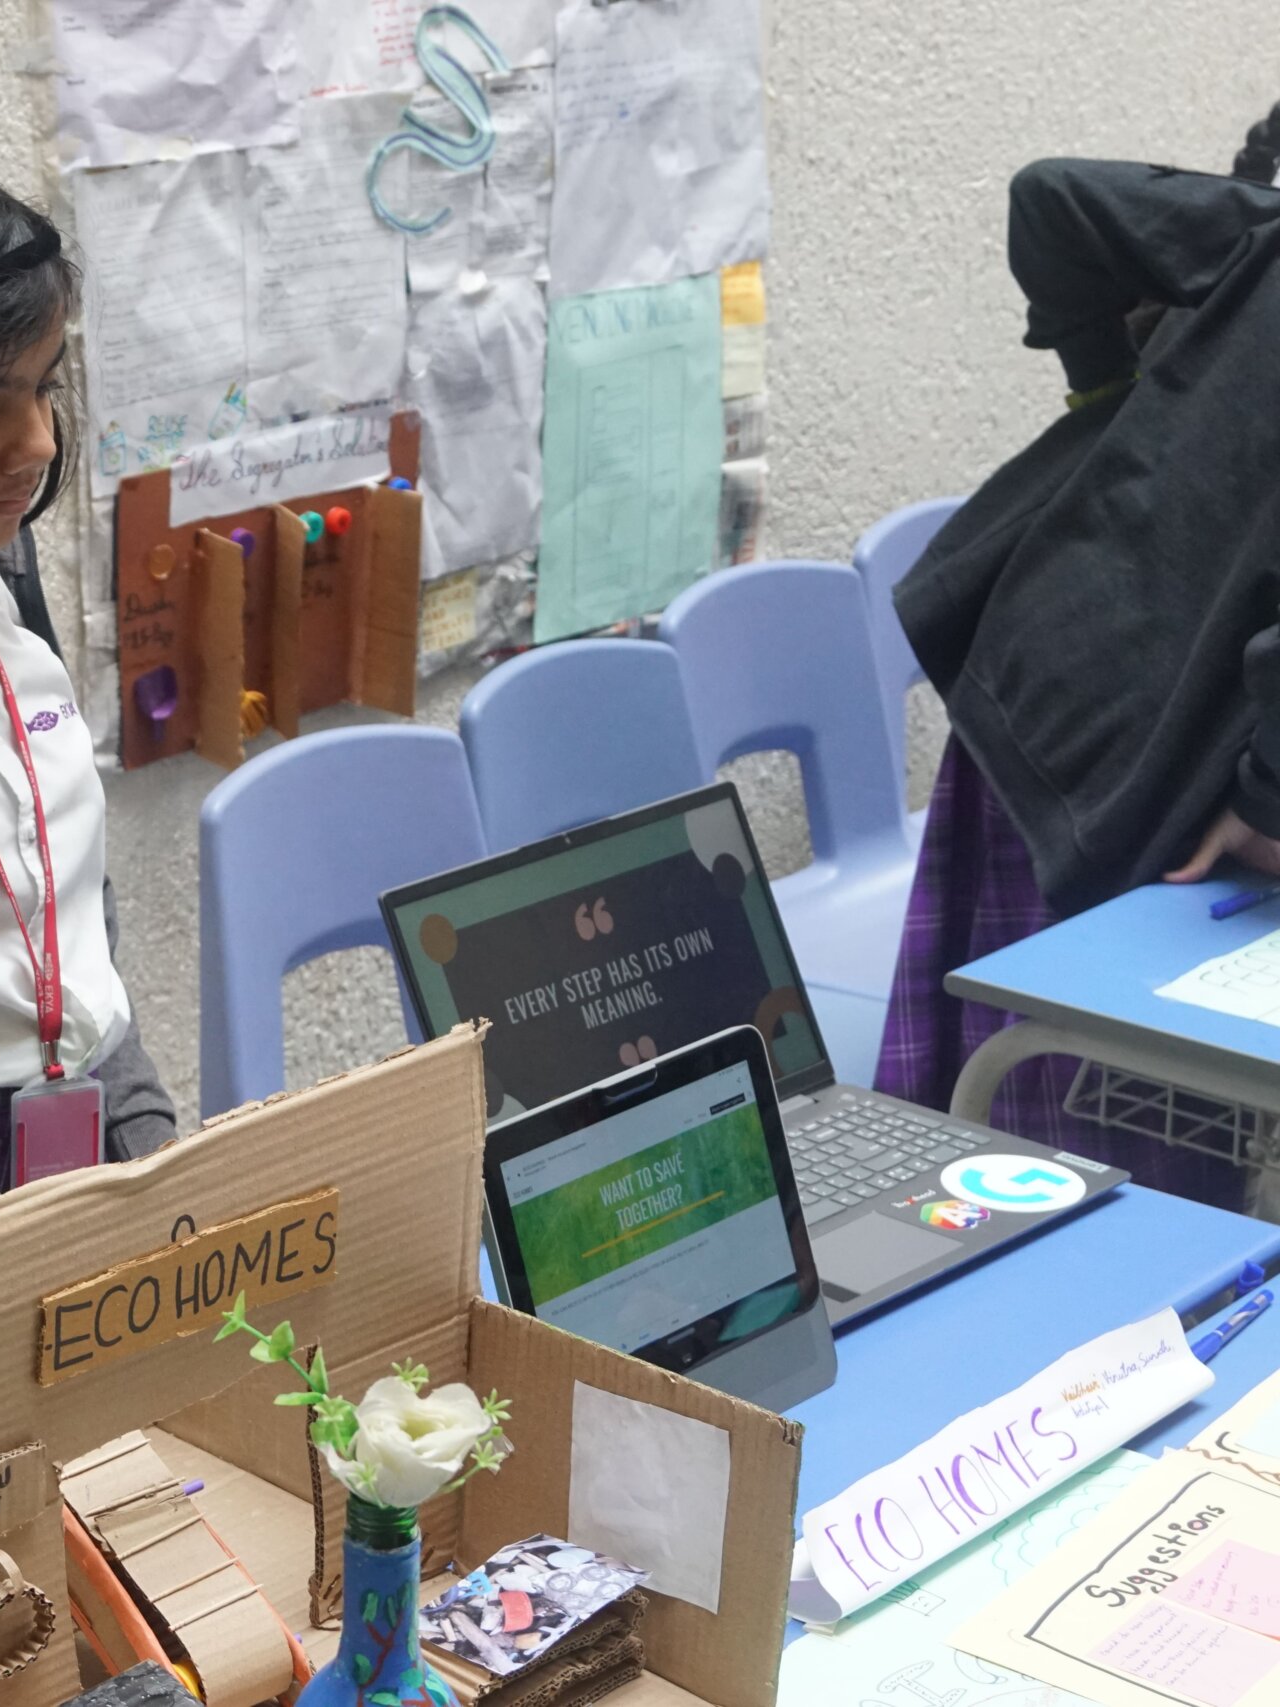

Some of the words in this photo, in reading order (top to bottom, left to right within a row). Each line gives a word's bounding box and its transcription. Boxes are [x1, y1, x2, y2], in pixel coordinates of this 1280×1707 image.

[44, 982, 55, 1015] EKYA
[505, 980, 561, 1025] EVERY
[562, 965, 602, 1003] STEP
[607, 951, 644, 987] HAS
[646, 939, 674, 972] ITS
[675, 926, 715, 962] OWN
[580, 979, 664, 1031] MEANING.
[598, 1173, 636, 1207] WANT
[634, 1166, 654, 1192] TO
[653, 1151, 686, 1184] SAVE
[615, 1183, 684, 1231] TOGETHER?
[53, 1275, 161, 1371] ECO
[174, 1211, 337, 1319] HOMES
[825, 1496, 925, 1592] ECO
[918, 1406, 1080, 1537] HOMES
[1084, 1502, 1226, 1608] Suggestions
